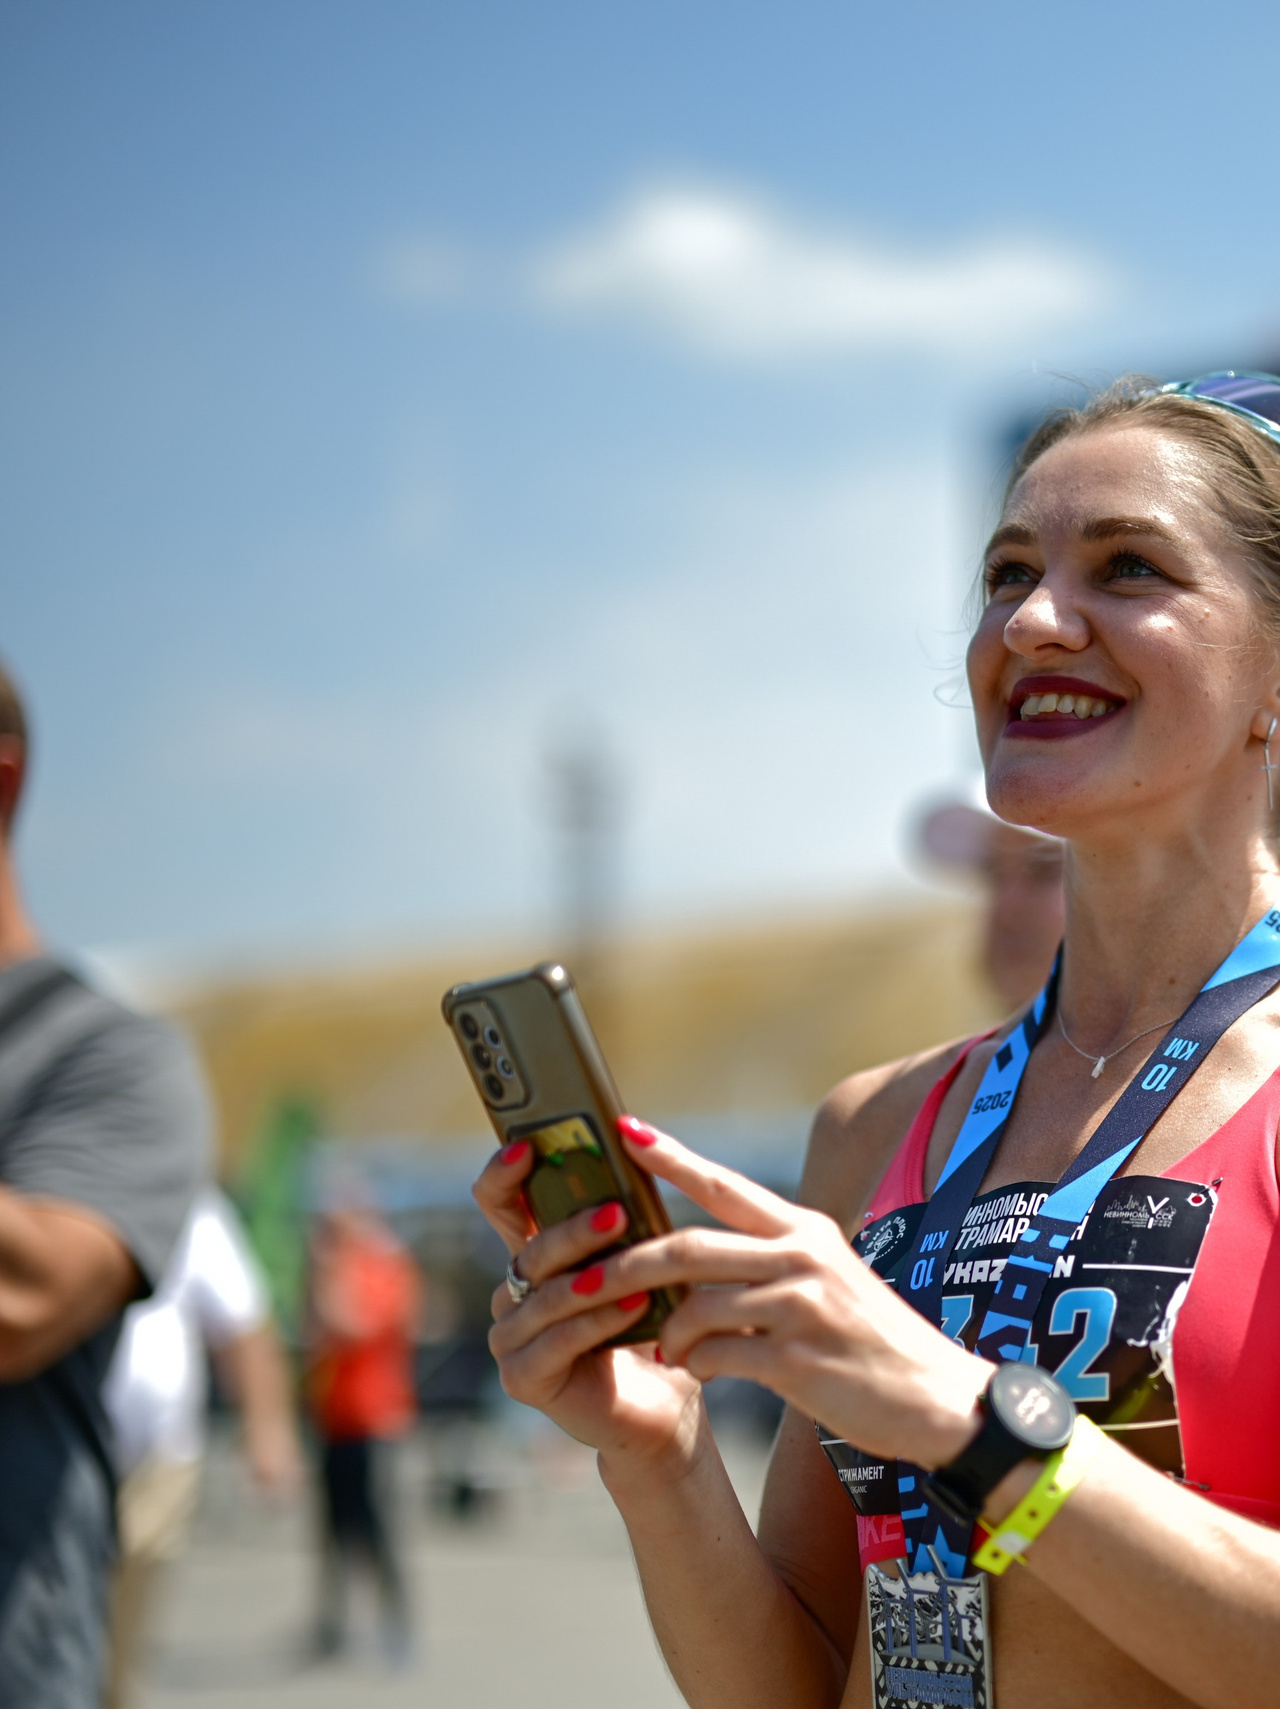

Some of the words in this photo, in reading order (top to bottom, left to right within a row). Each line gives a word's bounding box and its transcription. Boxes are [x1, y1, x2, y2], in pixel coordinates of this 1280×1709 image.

[1141, 1063, 1178, 1092] 10
[972, 1090, 1012, 1115] 2025
[910, 1257, 935, 1290] 10
